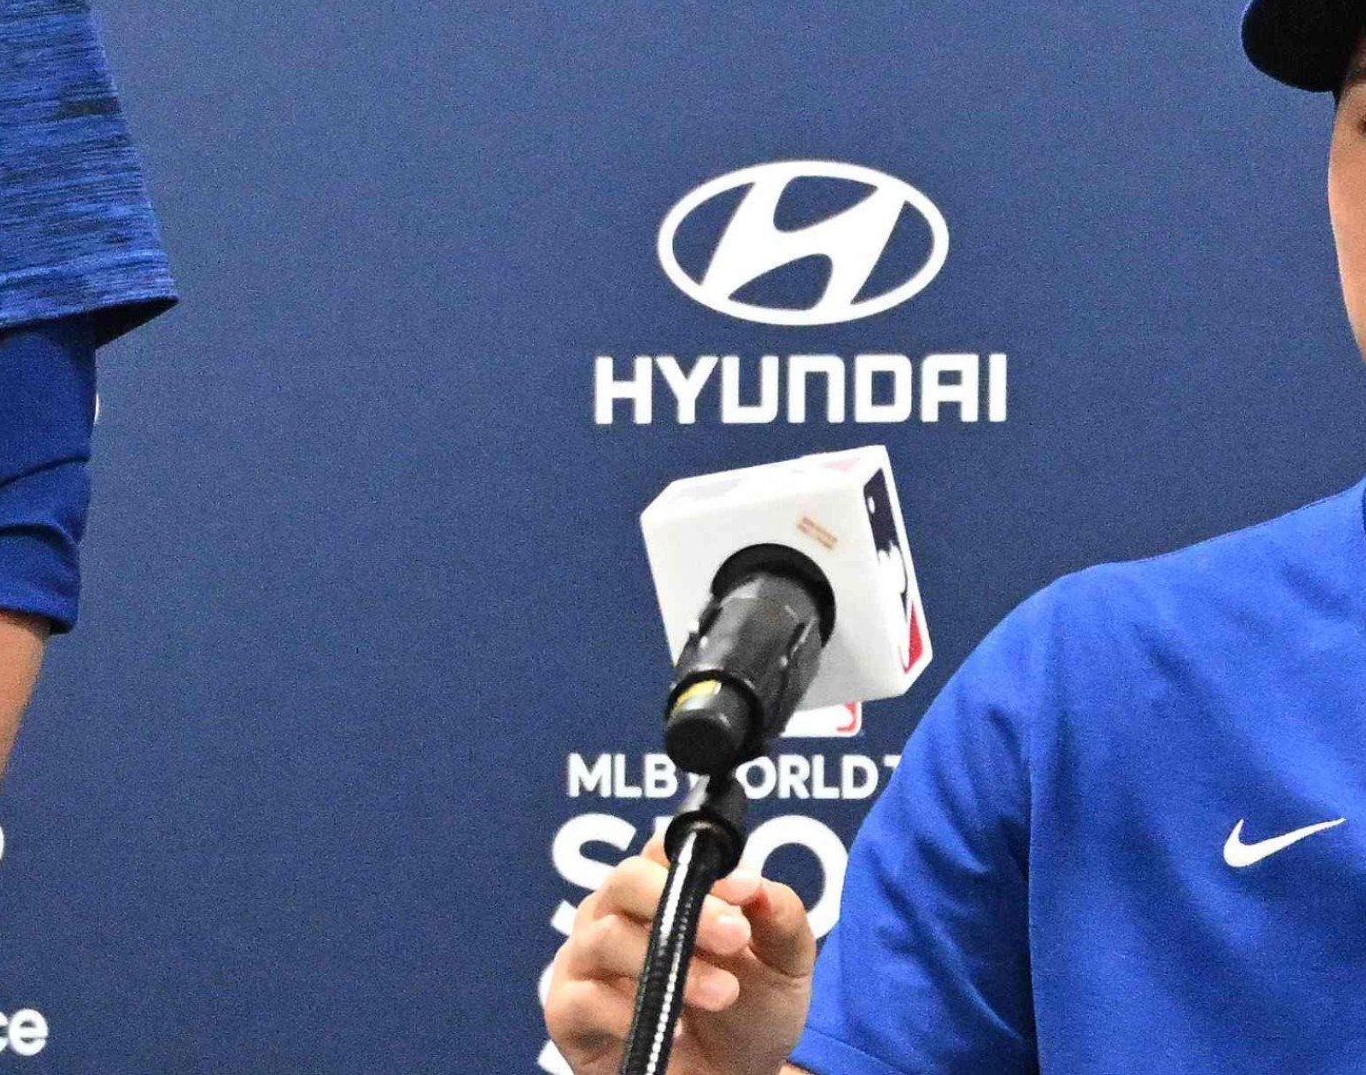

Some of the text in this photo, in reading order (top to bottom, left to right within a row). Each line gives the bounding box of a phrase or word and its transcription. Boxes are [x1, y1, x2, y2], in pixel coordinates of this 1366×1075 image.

[594, 353, 1007, 425] HYUNDAI
[567, 753, 678, 798] MLB
[685, 754, 879, 800] ORLD
